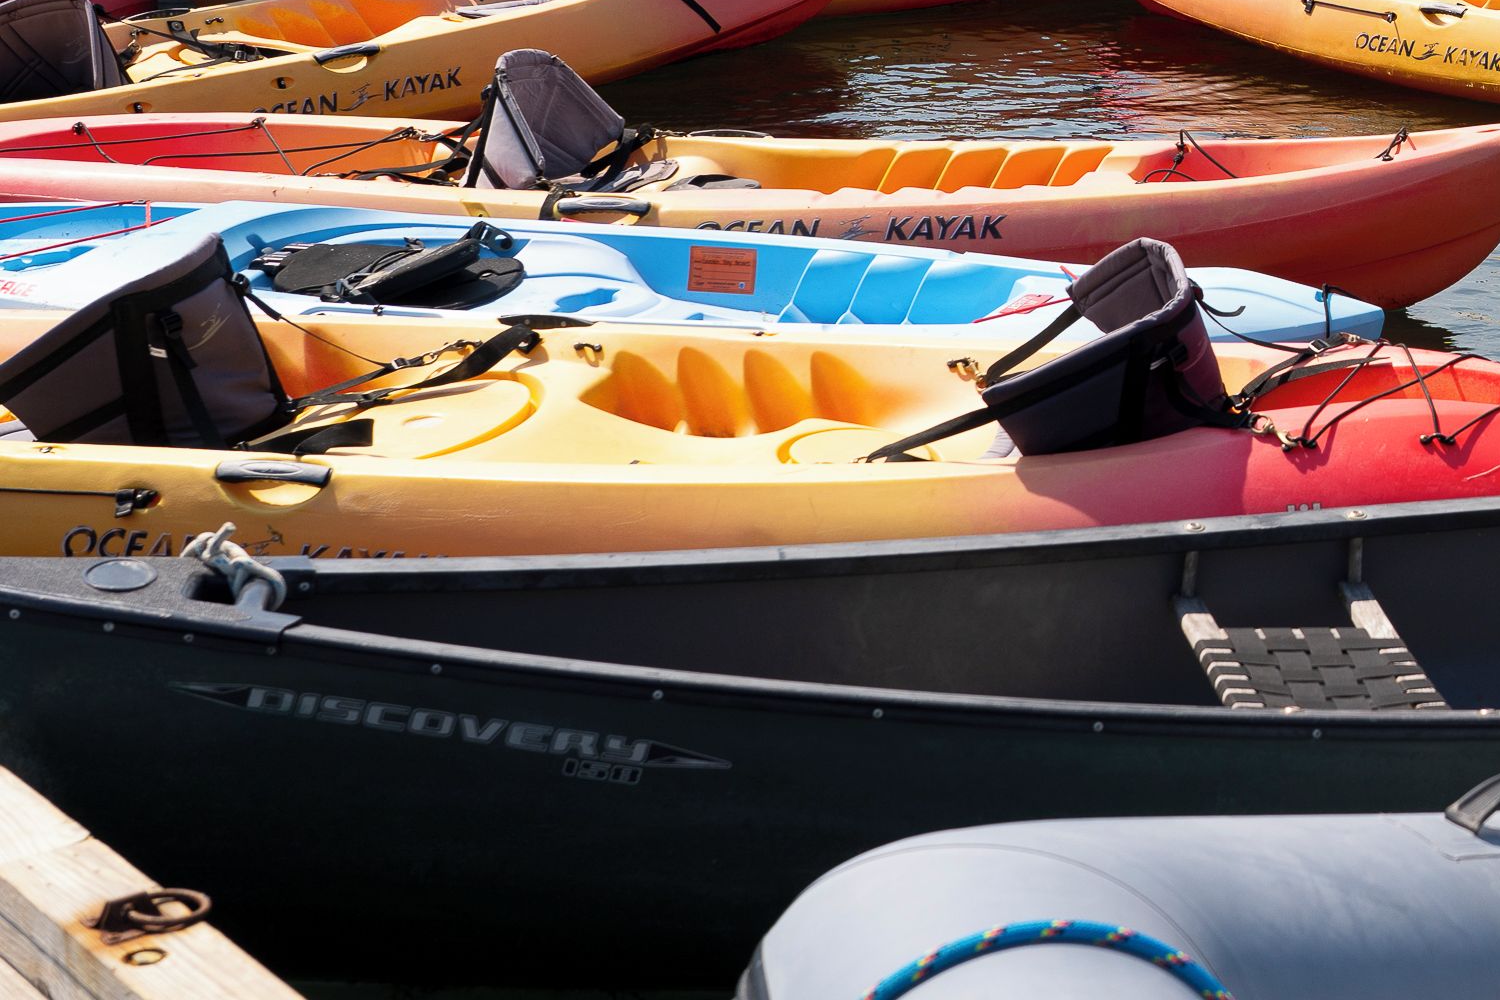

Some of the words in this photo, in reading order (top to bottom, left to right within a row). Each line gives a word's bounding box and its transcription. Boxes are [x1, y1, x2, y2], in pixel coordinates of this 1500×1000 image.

[1355, 31, 1416, 57] OCEAN
[383, 66, 462, 101] KAYAK
[883, 214, 1007, 241] KAYAK
[62, 525, 196, 557] OCEA
[245, 683, 650, 765] DISCOVERY
